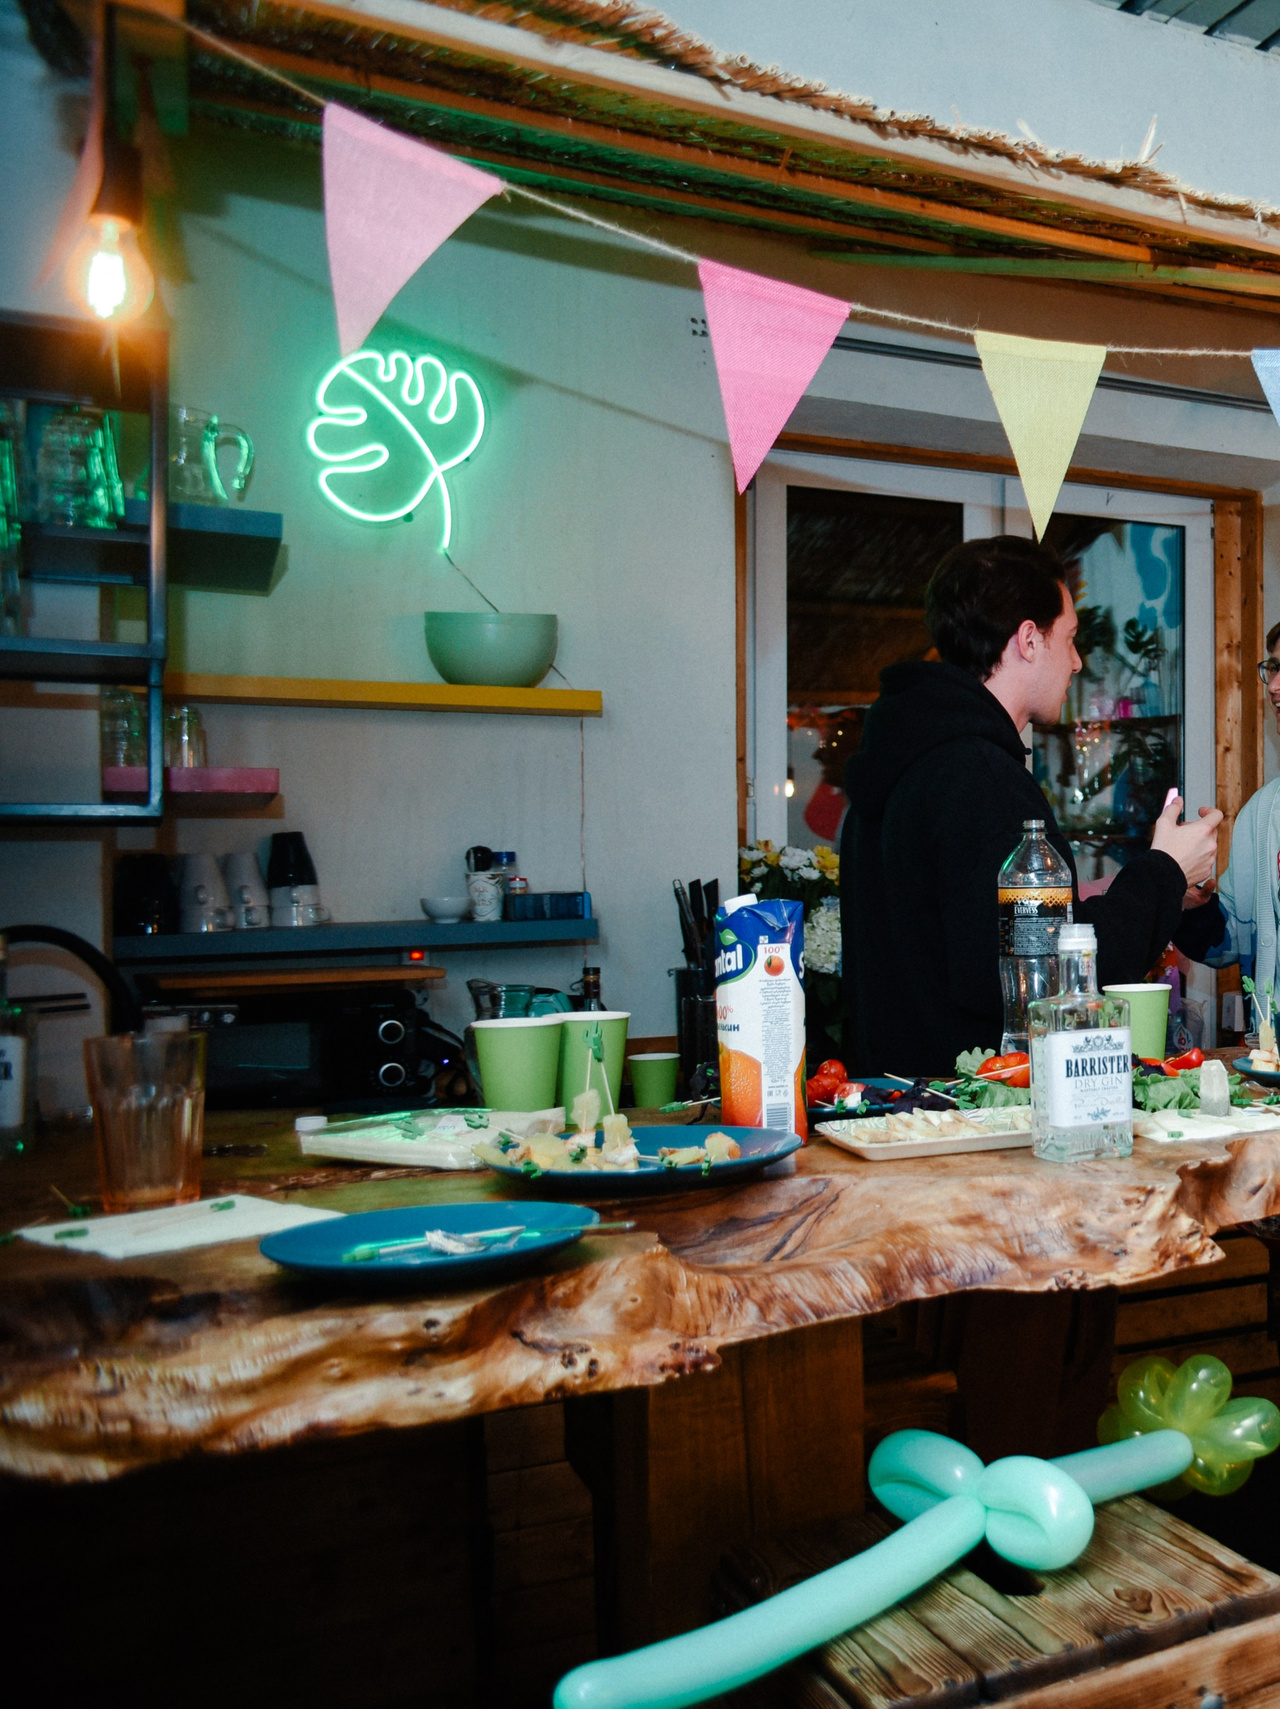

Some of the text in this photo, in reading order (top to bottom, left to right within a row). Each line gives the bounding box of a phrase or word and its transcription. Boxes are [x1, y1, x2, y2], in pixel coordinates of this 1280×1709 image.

[1014, 905, 1039, 915] EVERVESS
[714, 943, 743, 978] ntal
[1065, 1054, 1130, 1078] BARRISTER
[1074, 1075, 1123, 1089] DRY GIN
